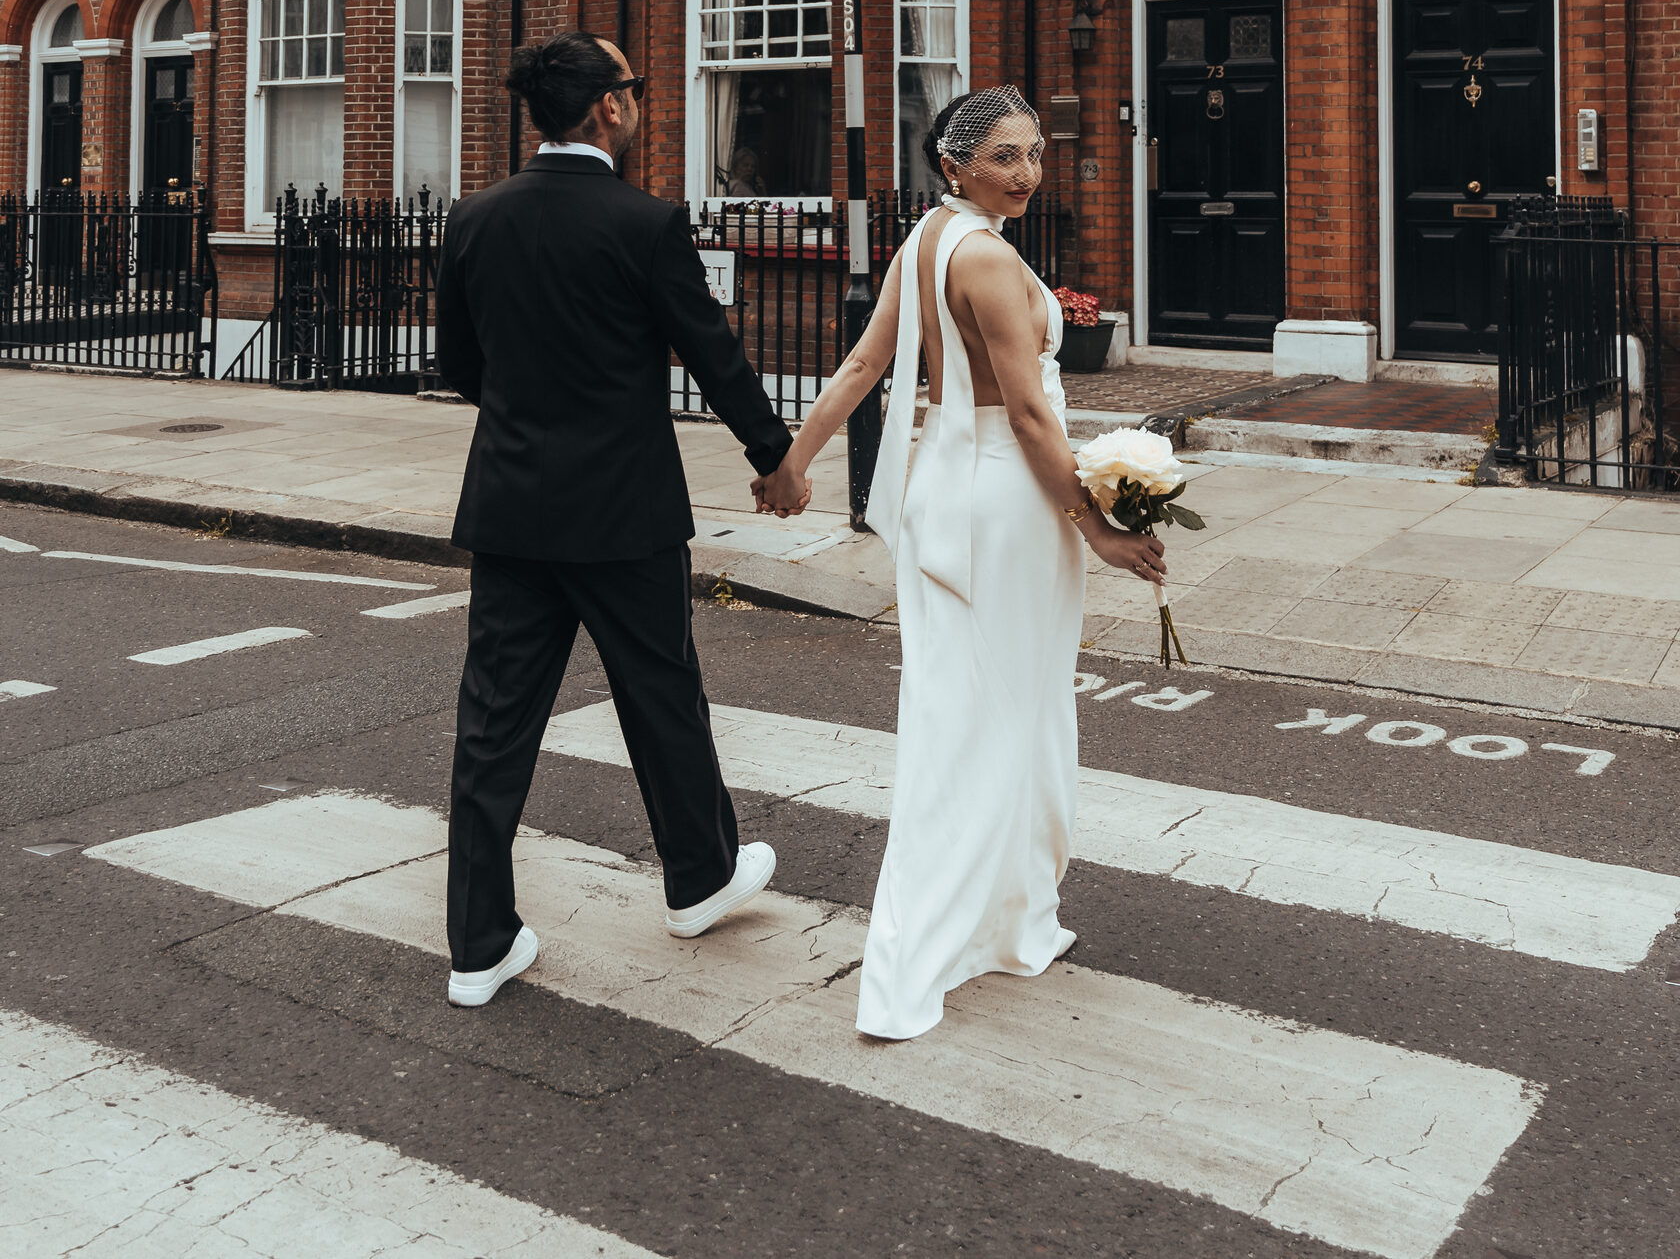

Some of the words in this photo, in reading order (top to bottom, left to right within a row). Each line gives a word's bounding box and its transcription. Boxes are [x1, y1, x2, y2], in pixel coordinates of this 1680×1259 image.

[1462, 55, 1485, 70] 74
[1206, 65, 1225, 79] 73
[1274, 708, 1616, 776] LOOK
